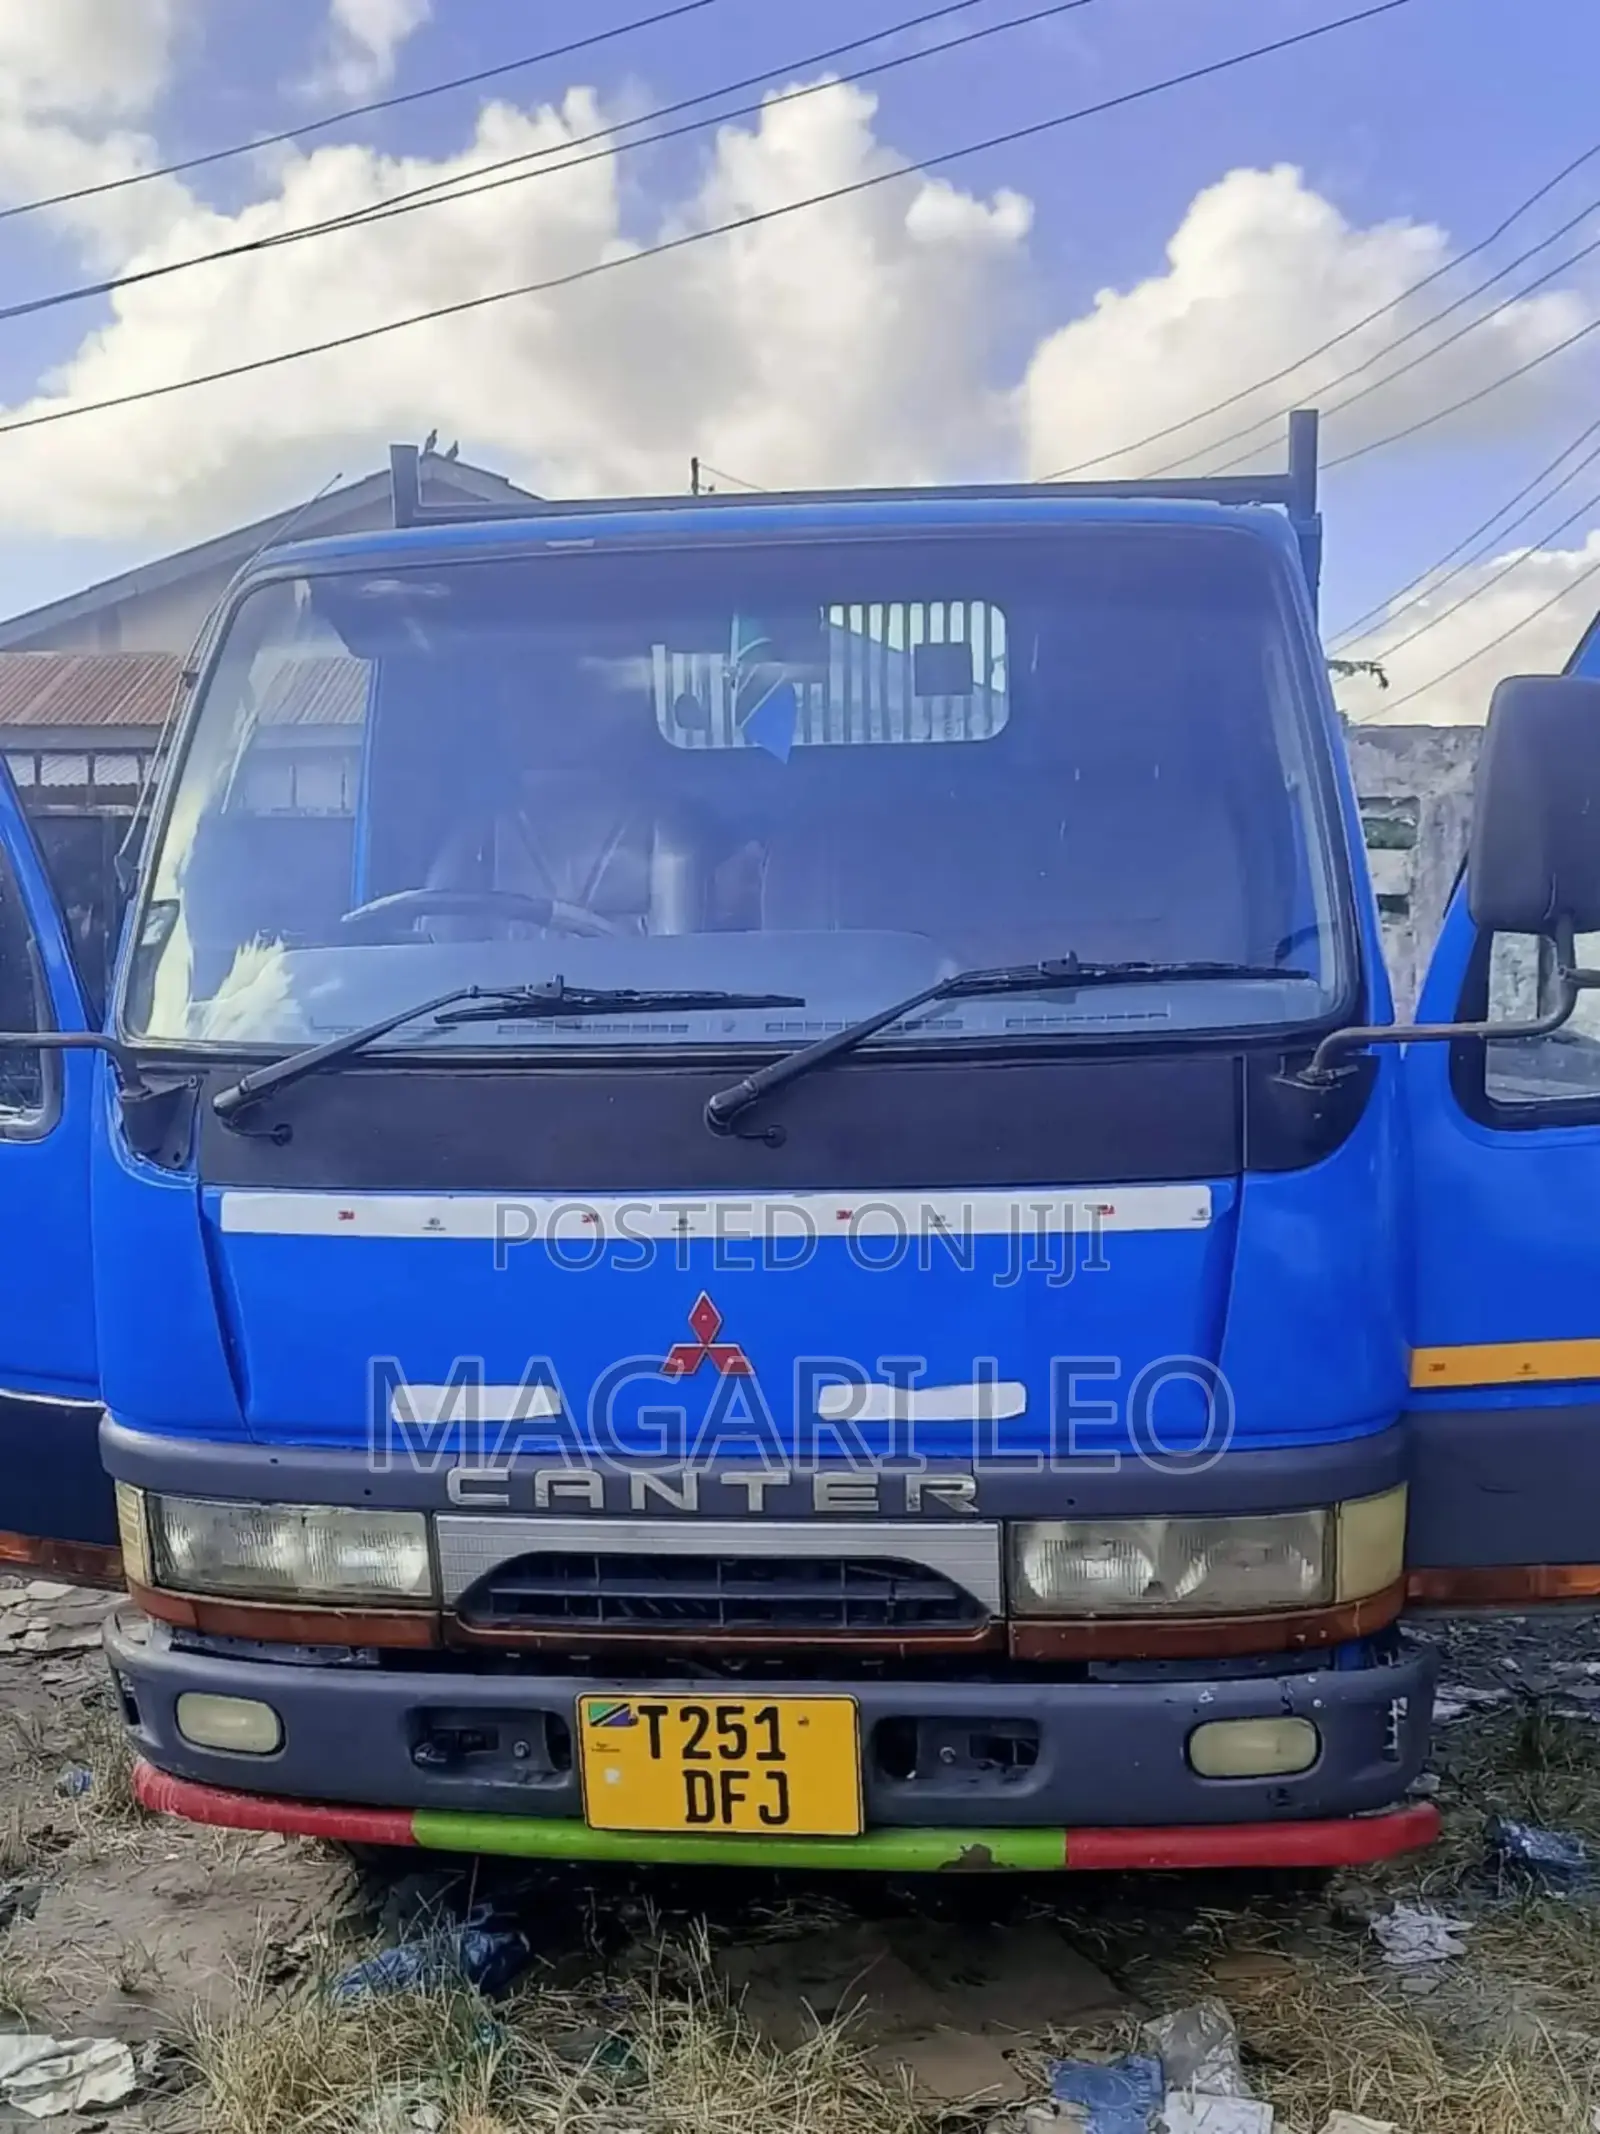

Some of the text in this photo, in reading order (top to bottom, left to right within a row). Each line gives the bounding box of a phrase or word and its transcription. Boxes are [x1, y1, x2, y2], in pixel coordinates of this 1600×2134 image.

[447, 1467, 980, 1513] CANTER
[638, 1704, 787, 1761] T 251
[682, 1769, 790, 1826] DFJ
